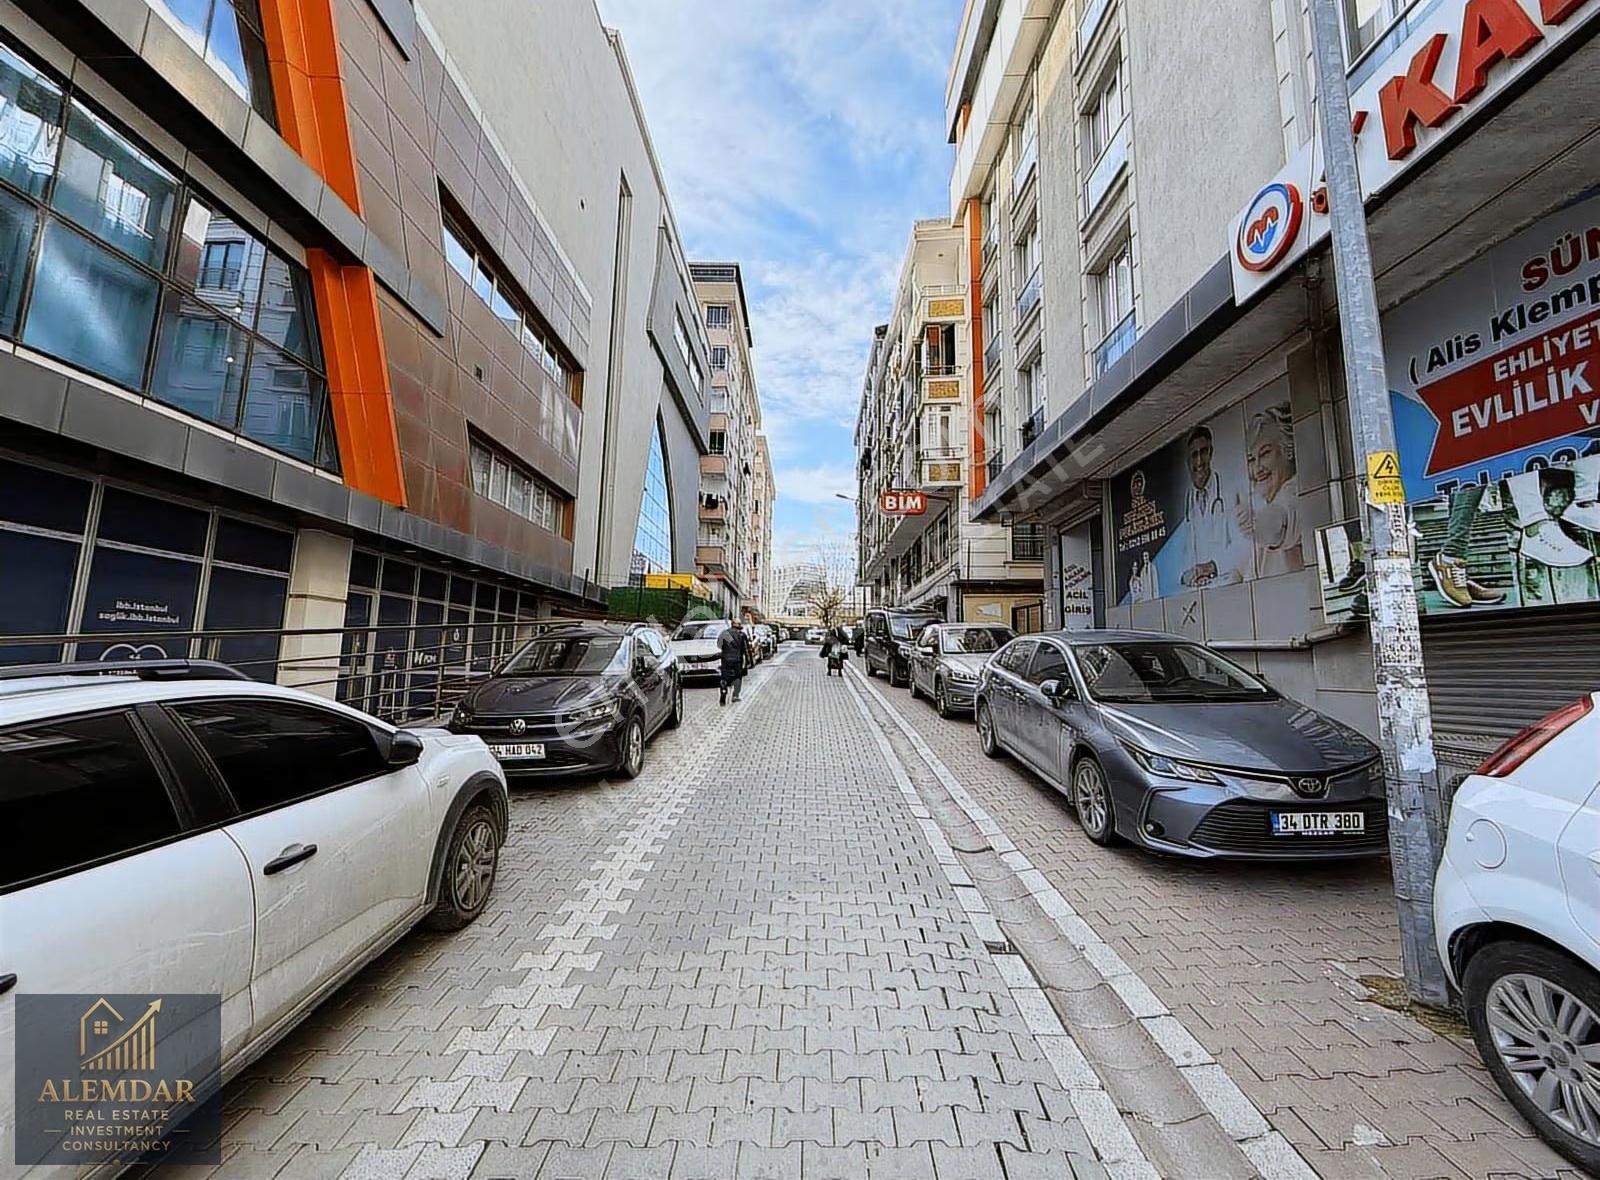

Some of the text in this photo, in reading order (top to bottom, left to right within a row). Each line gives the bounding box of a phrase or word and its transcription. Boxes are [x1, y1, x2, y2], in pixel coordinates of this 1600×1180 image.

[1378, 0, 1588, 160] KA
[1426, 332, 1482, 374] Alis
[1451, 360, 1593, 438] EVLİLİK
[885, 491, 922, 510] BİM
[1281, 813, 1360, 830] 34 DTR 380
